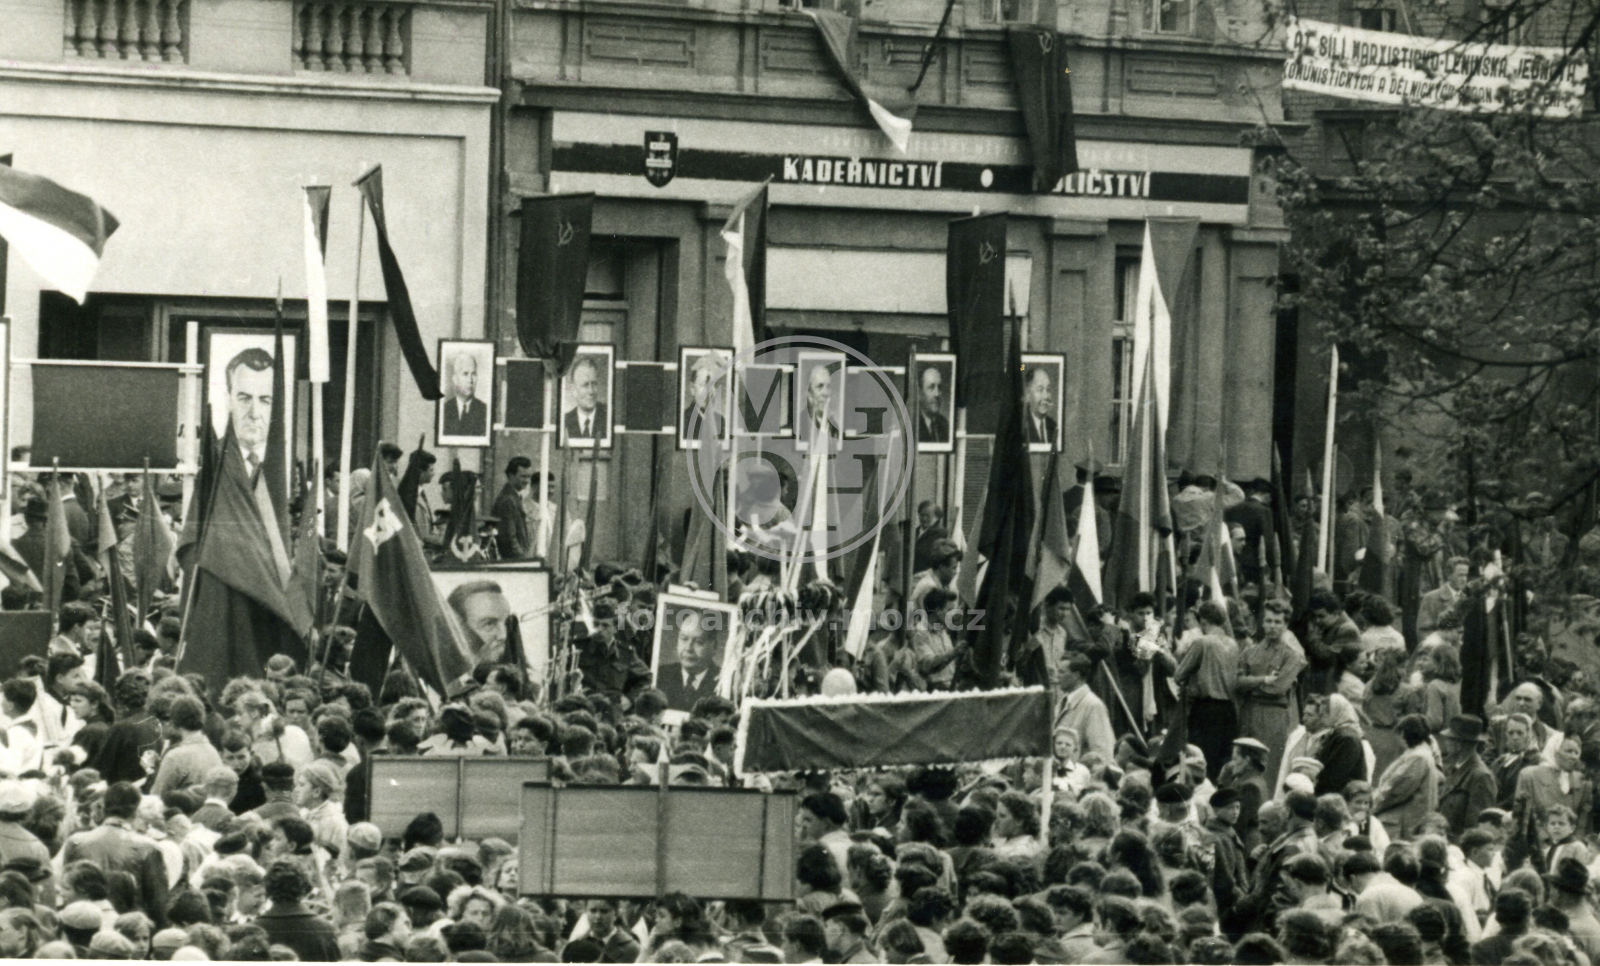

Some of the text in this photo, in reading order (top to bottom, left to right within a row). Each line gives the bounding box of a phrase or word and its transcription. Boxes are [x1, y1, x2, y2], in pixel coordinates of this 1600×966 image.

[1378, 76, 1388, 93] A
[783, 156, 1152, 198] KADEŘNICTVÍ LIČSTVÍ
